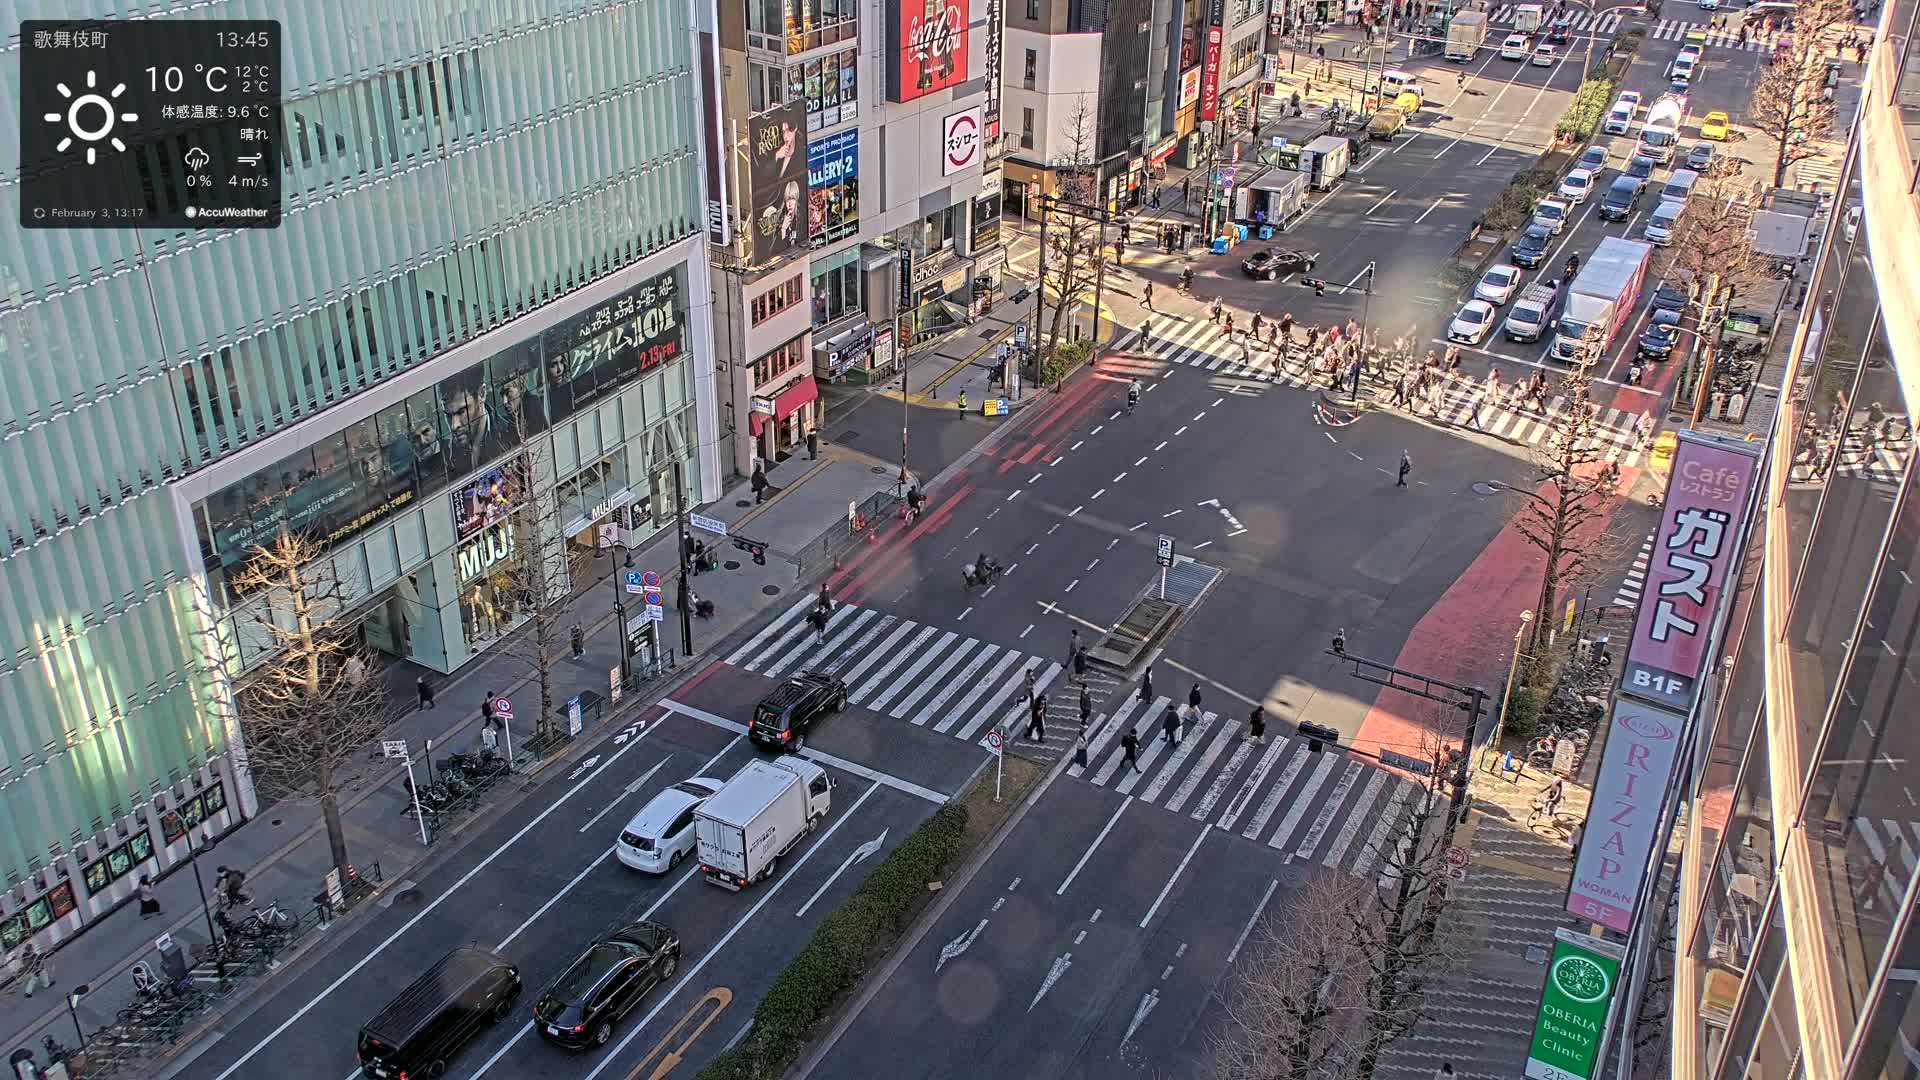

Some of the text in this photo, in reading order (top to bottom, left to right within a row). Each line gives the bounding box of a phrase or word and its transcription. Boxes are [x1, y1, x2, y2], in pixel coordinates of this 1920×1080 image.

[1205, 46, 1218, 110] バーガーキング
[810, 142, 831, 154] SPORTS
[841, 133, 855, 144] SHOP
[947, 133, 978, 151] スシロー
[709, 200, 723, 233] MUJI
[640, 341, 676, 370] 2.13 FRI
[830, 352, 838, 367] P
[1682, 460, 1741, 489] Café
[1679, 482, 1736, 502] レストラン
[591, 498, 614, 520] MUJI
[458, 518, 516, 582] MUJI
[1650, 506, 1731, 642] ガスト
[1632, 669, 1684, 695] B1F
[1600, 742, 1651, 880] RIZAP
[1577, 877, 1633, 905] WOMAN
[1584, 903, 1612, 921] 5F
[1559, 969, 1600, 991] OBERIA
[1543, 1004, 1597, 1032] OBERIA
[1543, 1020, 1590, 1047] Beauty
[1542, 1038, 1584, 1061] Clinic
